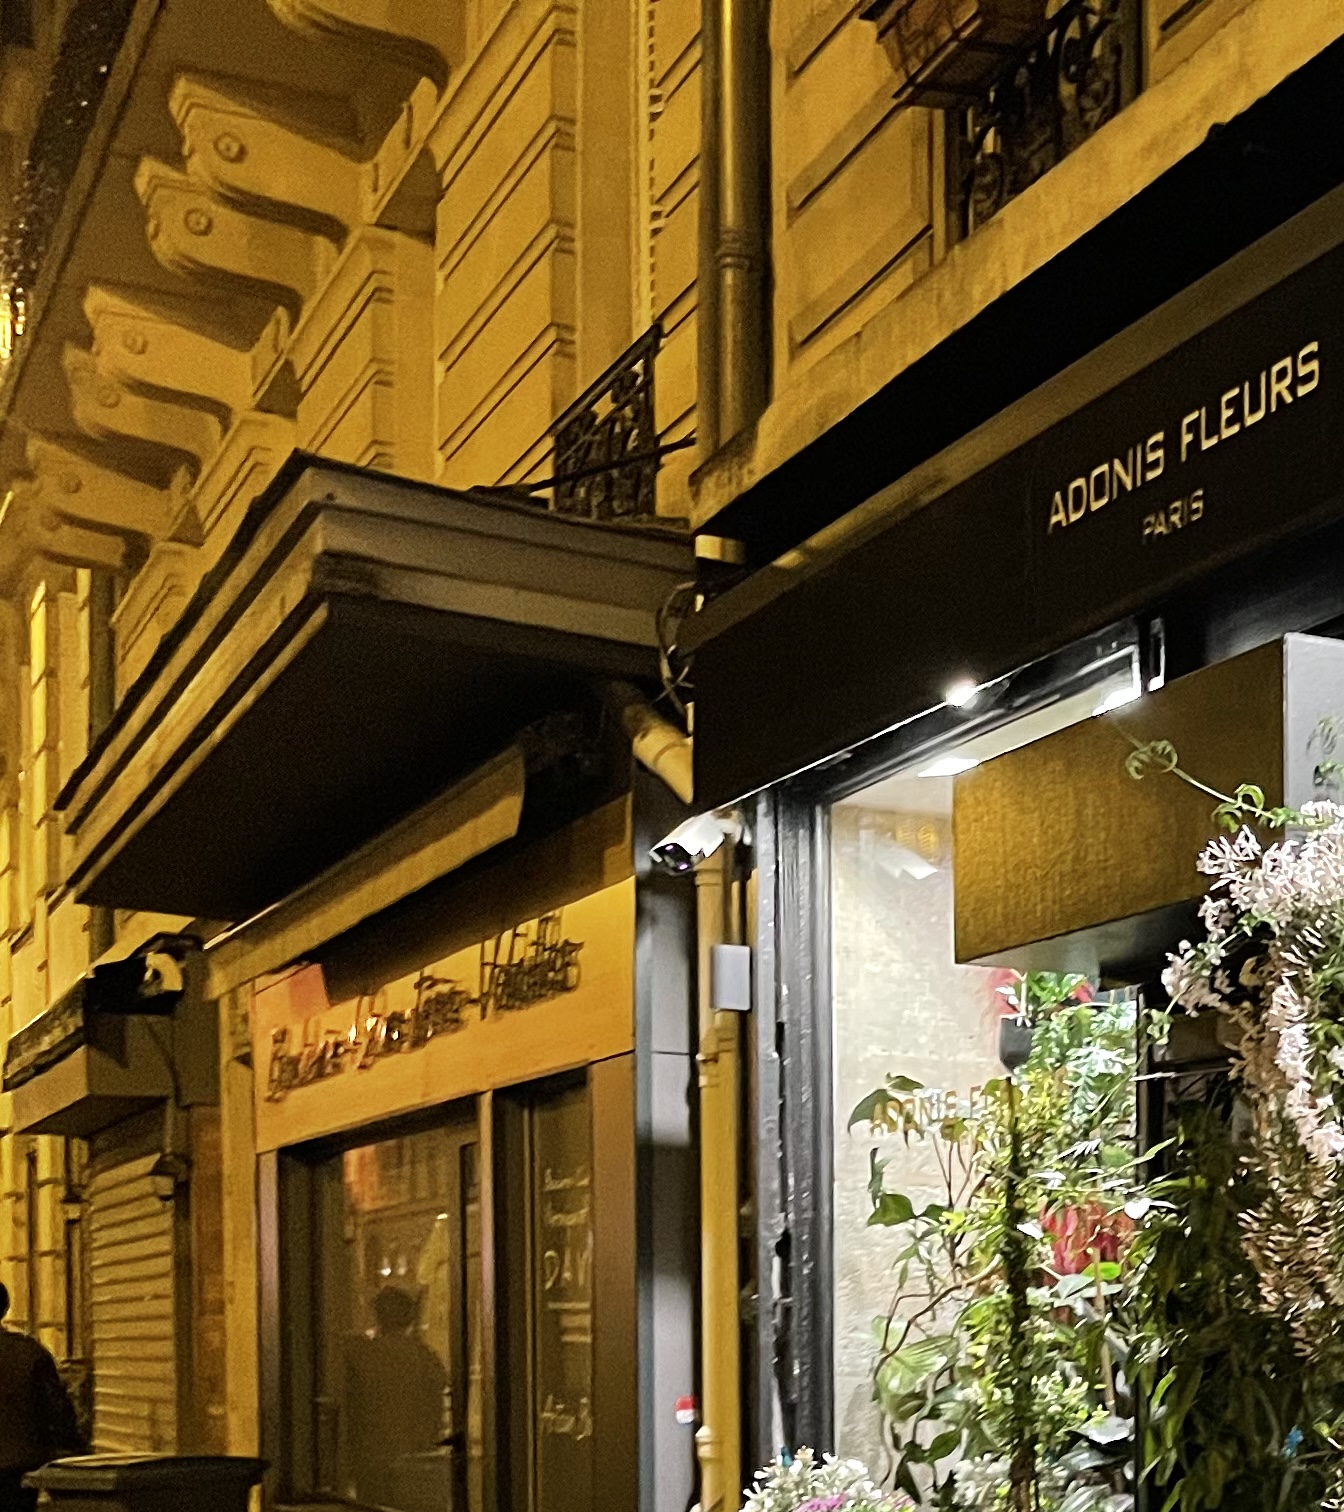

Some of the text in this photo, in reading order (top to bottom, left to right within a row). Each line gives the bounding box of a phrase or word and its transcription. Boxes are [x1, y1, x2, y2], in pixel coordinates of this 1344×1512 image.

[1048, 340, 1320, 534] ADONIS FLEURS
[1141, 488, 1204, 543] PARIS
